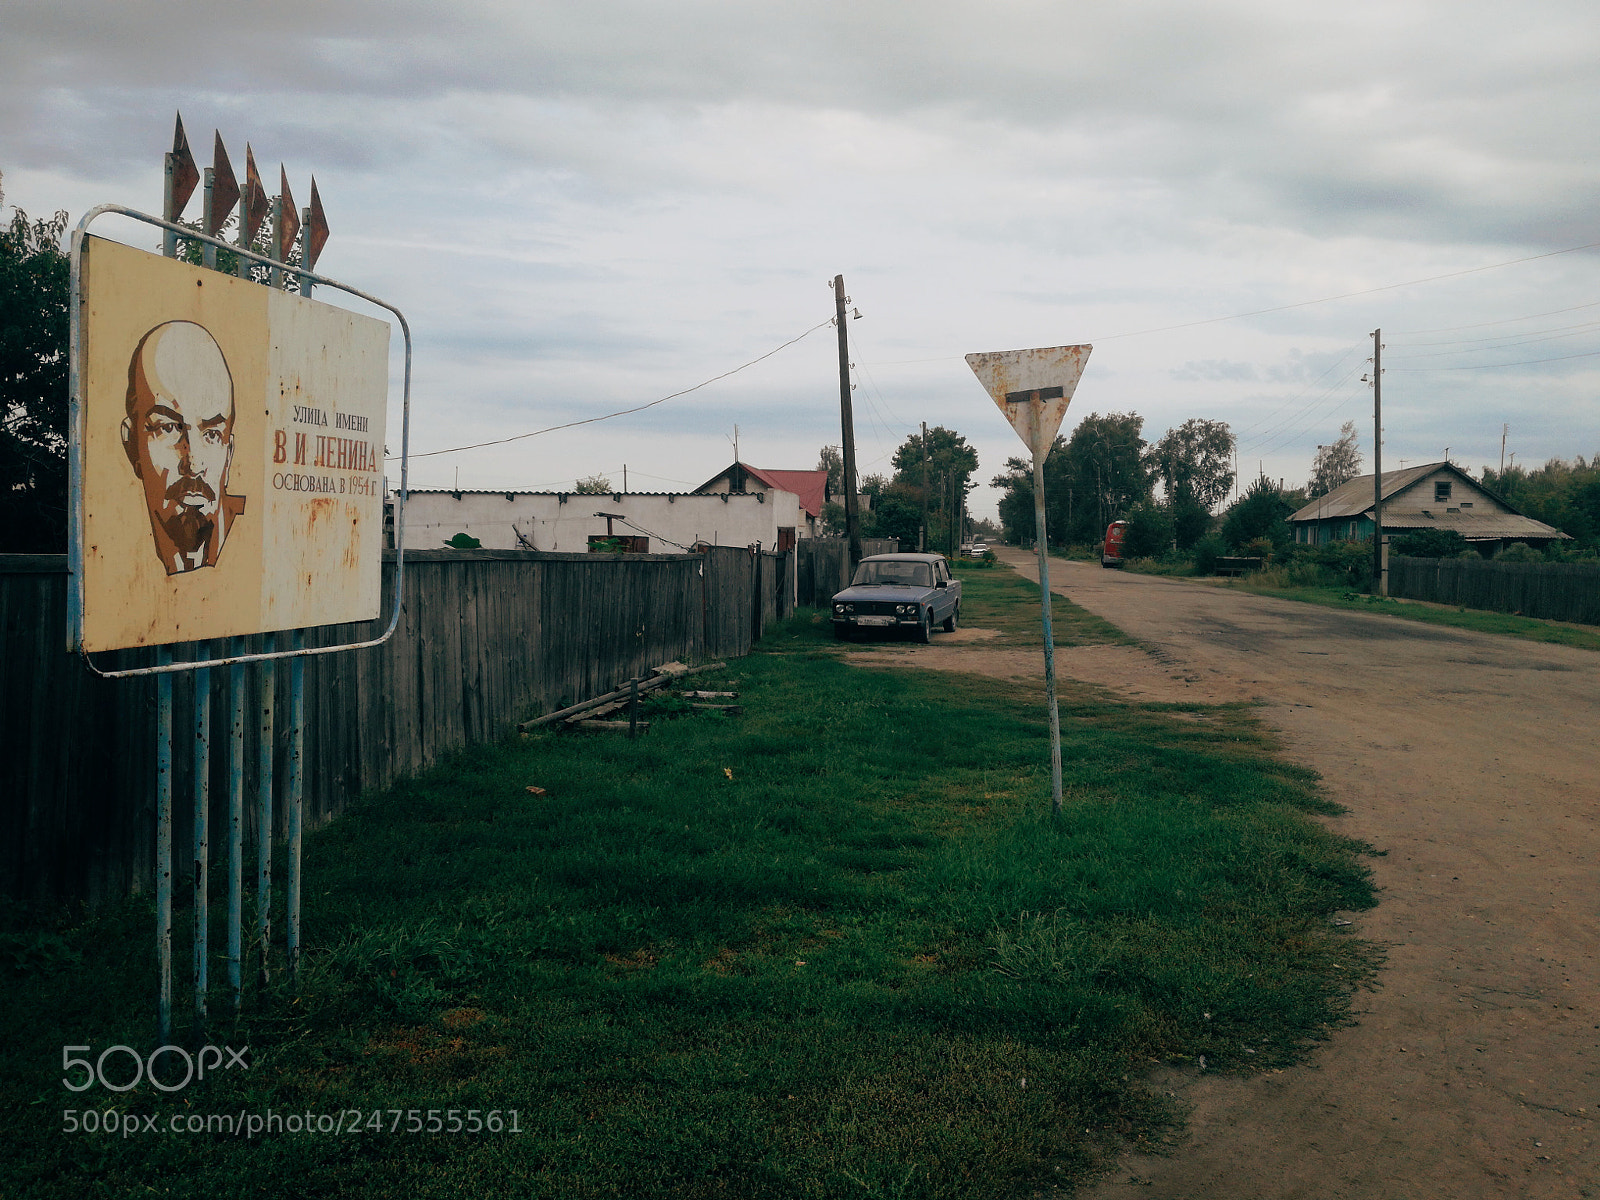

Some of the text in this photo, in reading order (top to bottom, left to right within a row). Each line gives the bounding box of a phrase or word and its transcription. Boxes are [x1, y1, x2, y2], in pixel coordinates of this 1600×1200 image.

[293, 405, 369, 433] УЛИЦА ИМЕНИ
[272, 472, 336, 494] ОСНОВАНА
[339, 477, 346, 494] В
[348, 475, 370, 496] 1954
